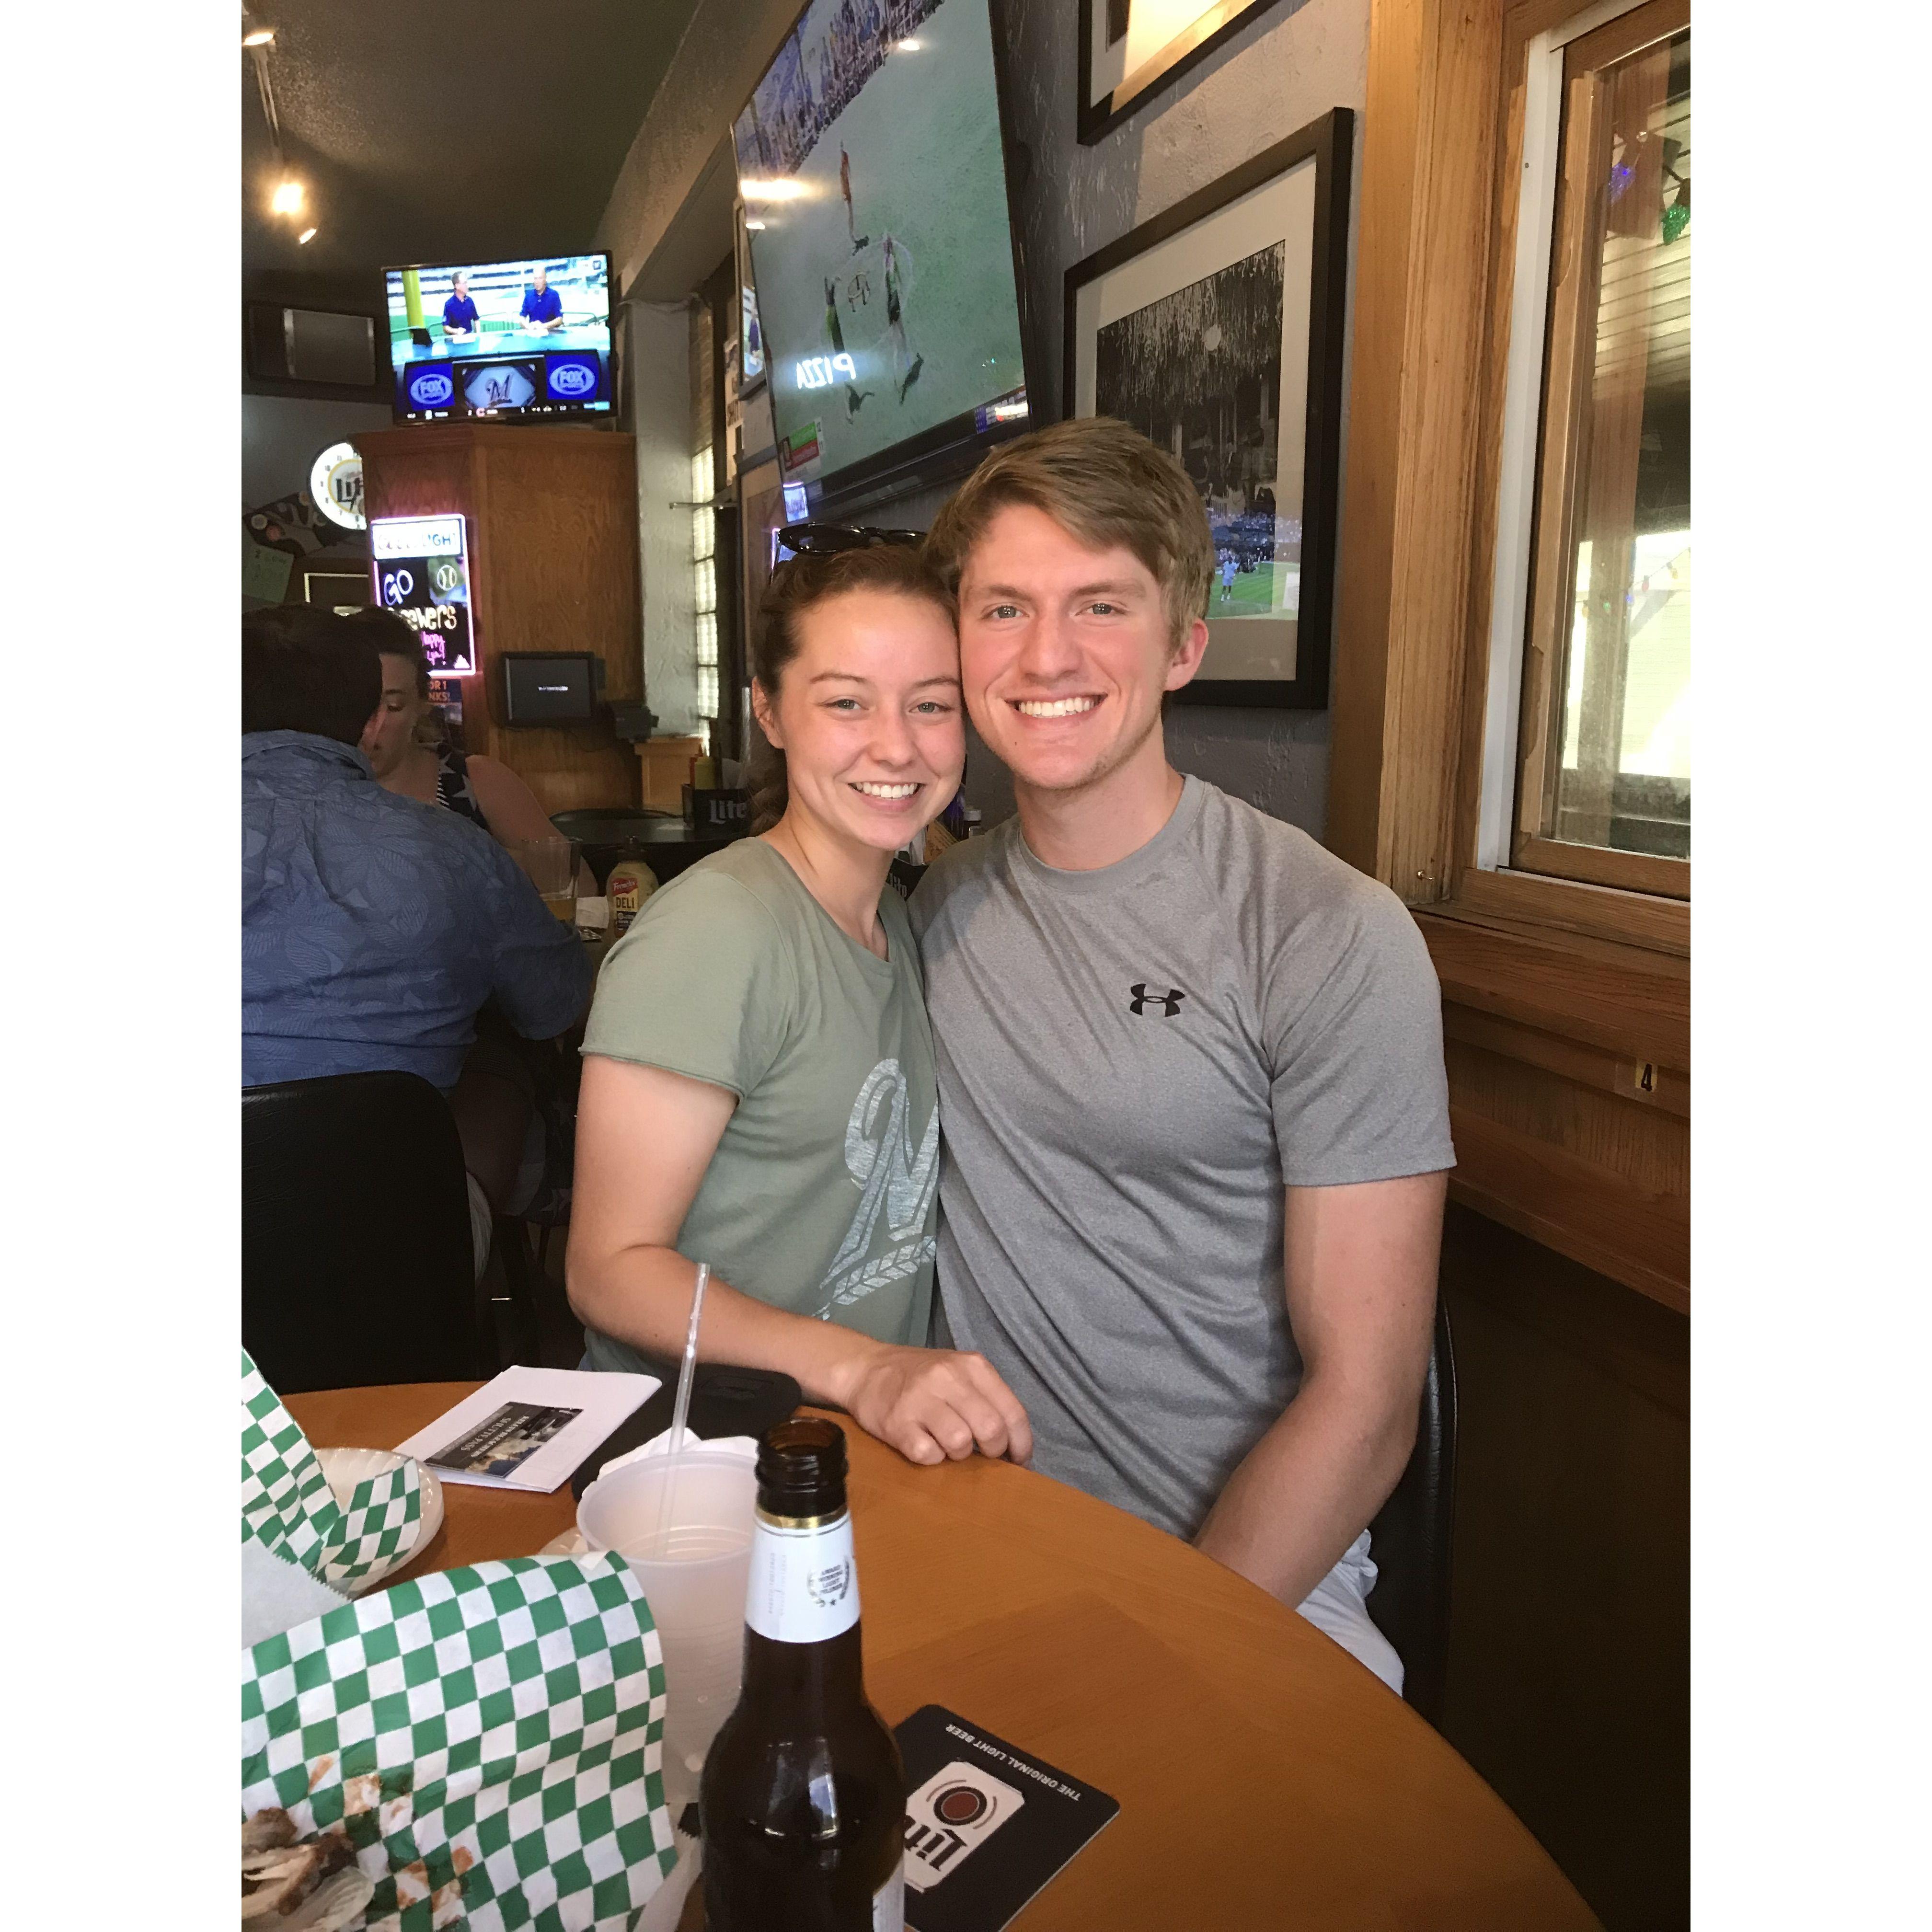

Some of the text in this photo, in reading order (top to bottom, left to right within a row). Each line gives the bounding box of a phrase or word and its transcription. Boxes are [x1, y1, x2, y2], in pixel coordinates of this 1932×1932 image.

[560, 370, 584, 383] FOX
[384, 570, 413, 606] GO
[709, 800, 748, 825] Lite
[616, 897, 634, 909] DELI
[1641, 1063, 1653, 1092] 4
[945, 1724, 1081, 1801] THE ORIGINAL LIGHT BEER
